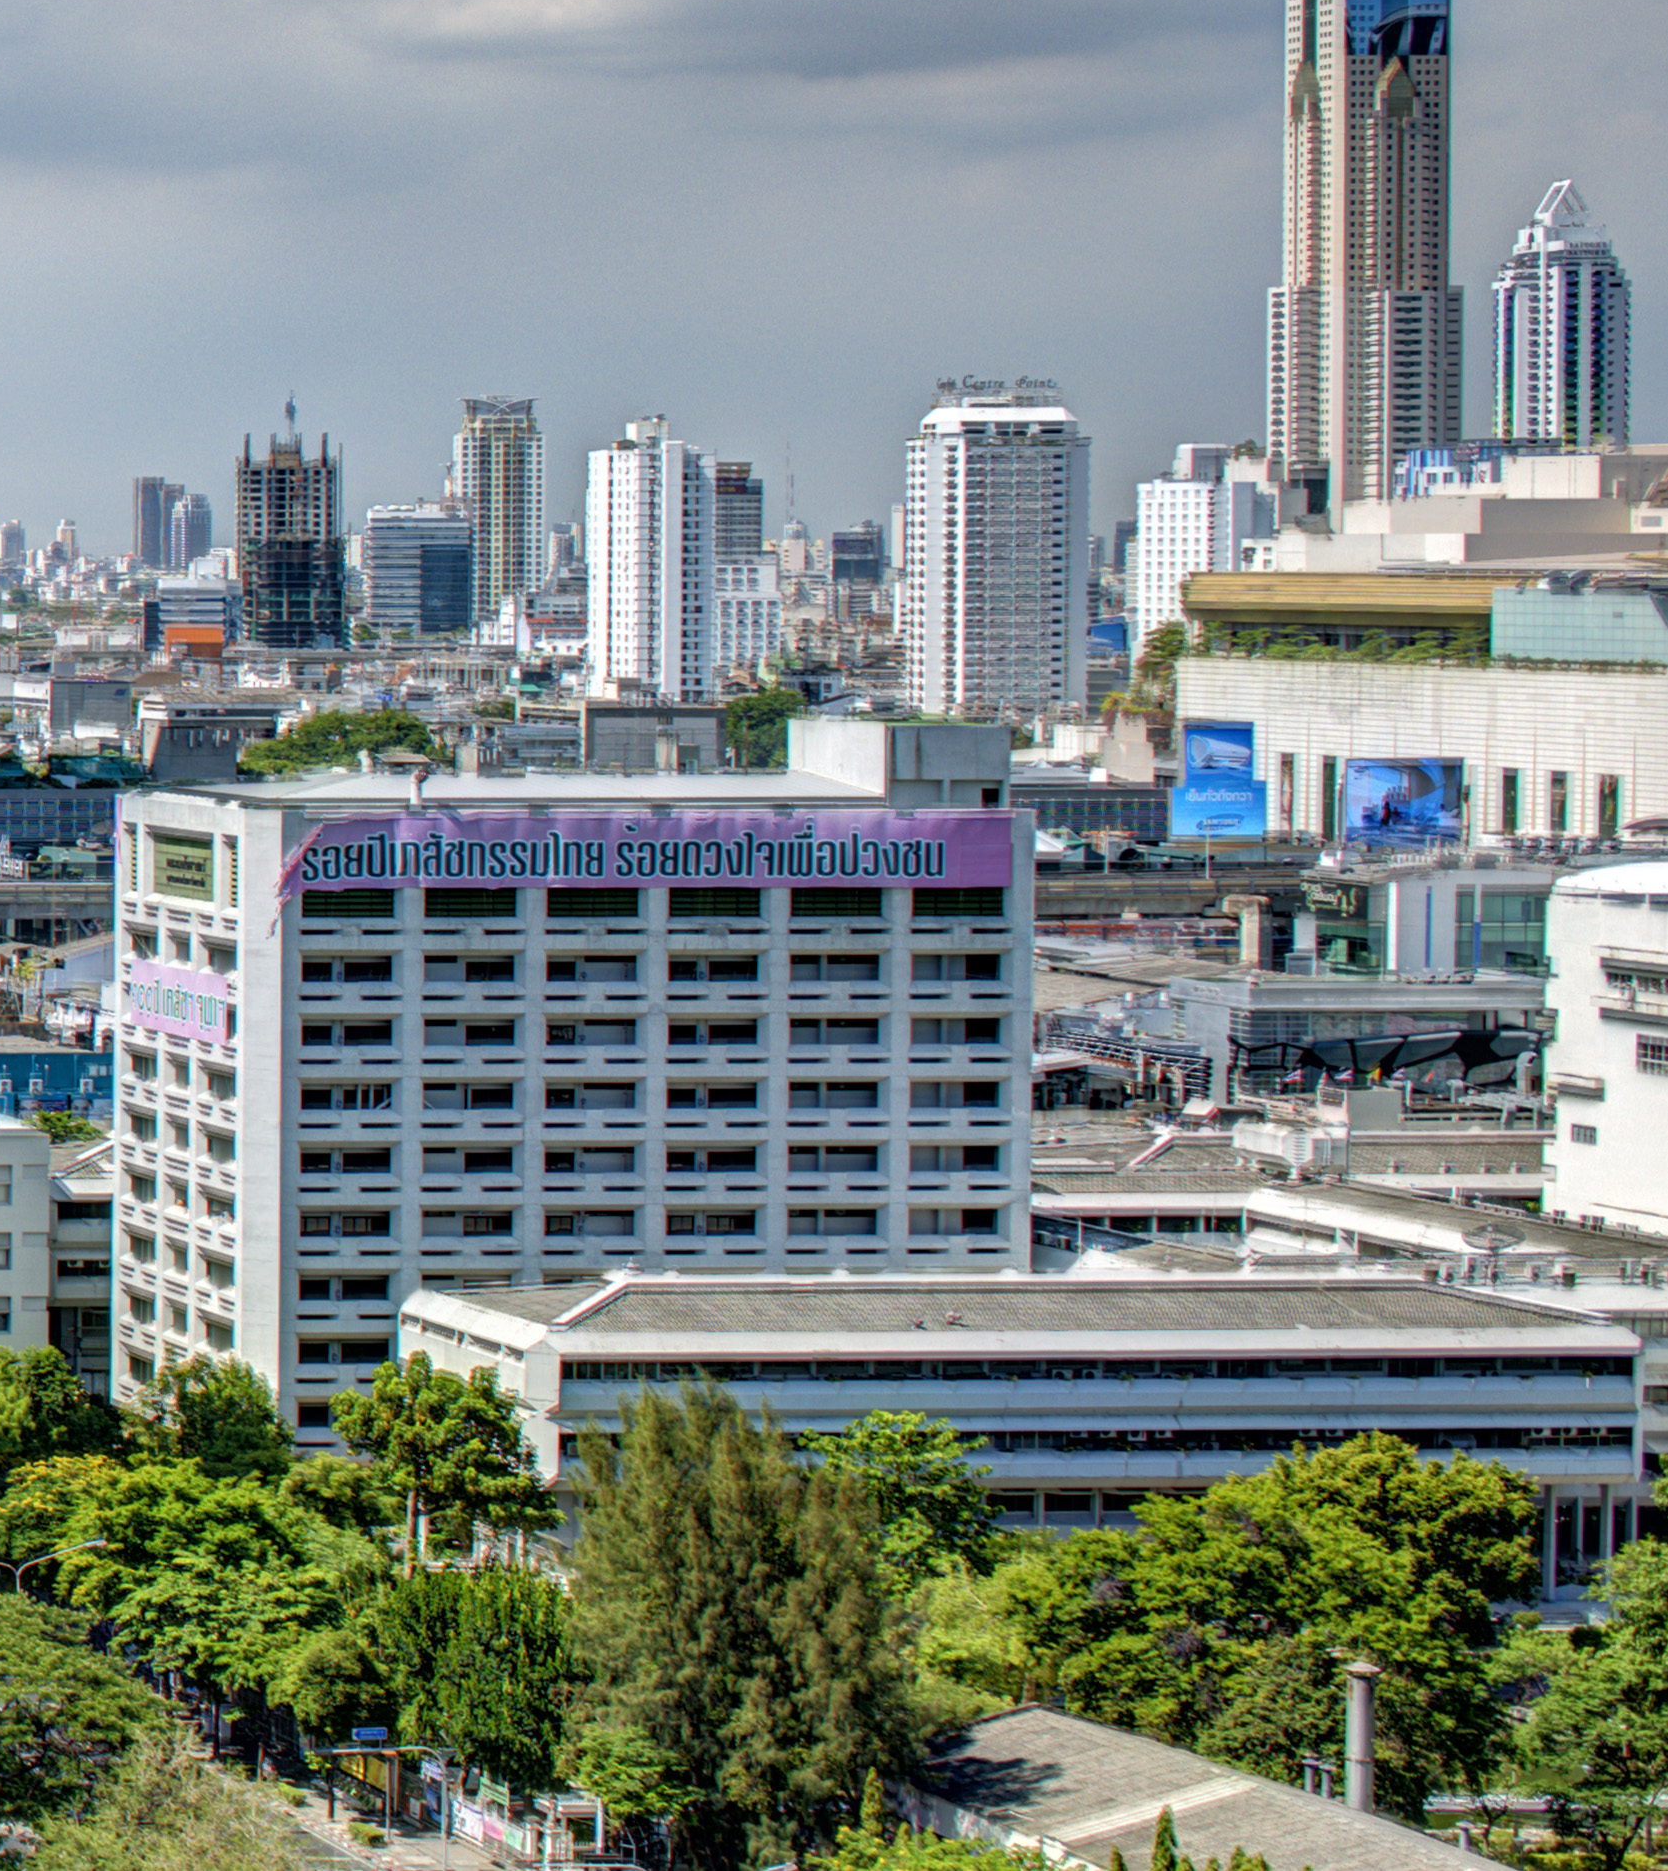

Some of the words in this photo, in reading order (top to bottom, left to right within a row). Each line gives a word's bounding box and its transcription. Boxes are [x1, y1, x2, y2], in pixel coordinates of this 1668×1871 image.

[300, 831, 604, 883] รอยปีเภสัชกรรมไทย
